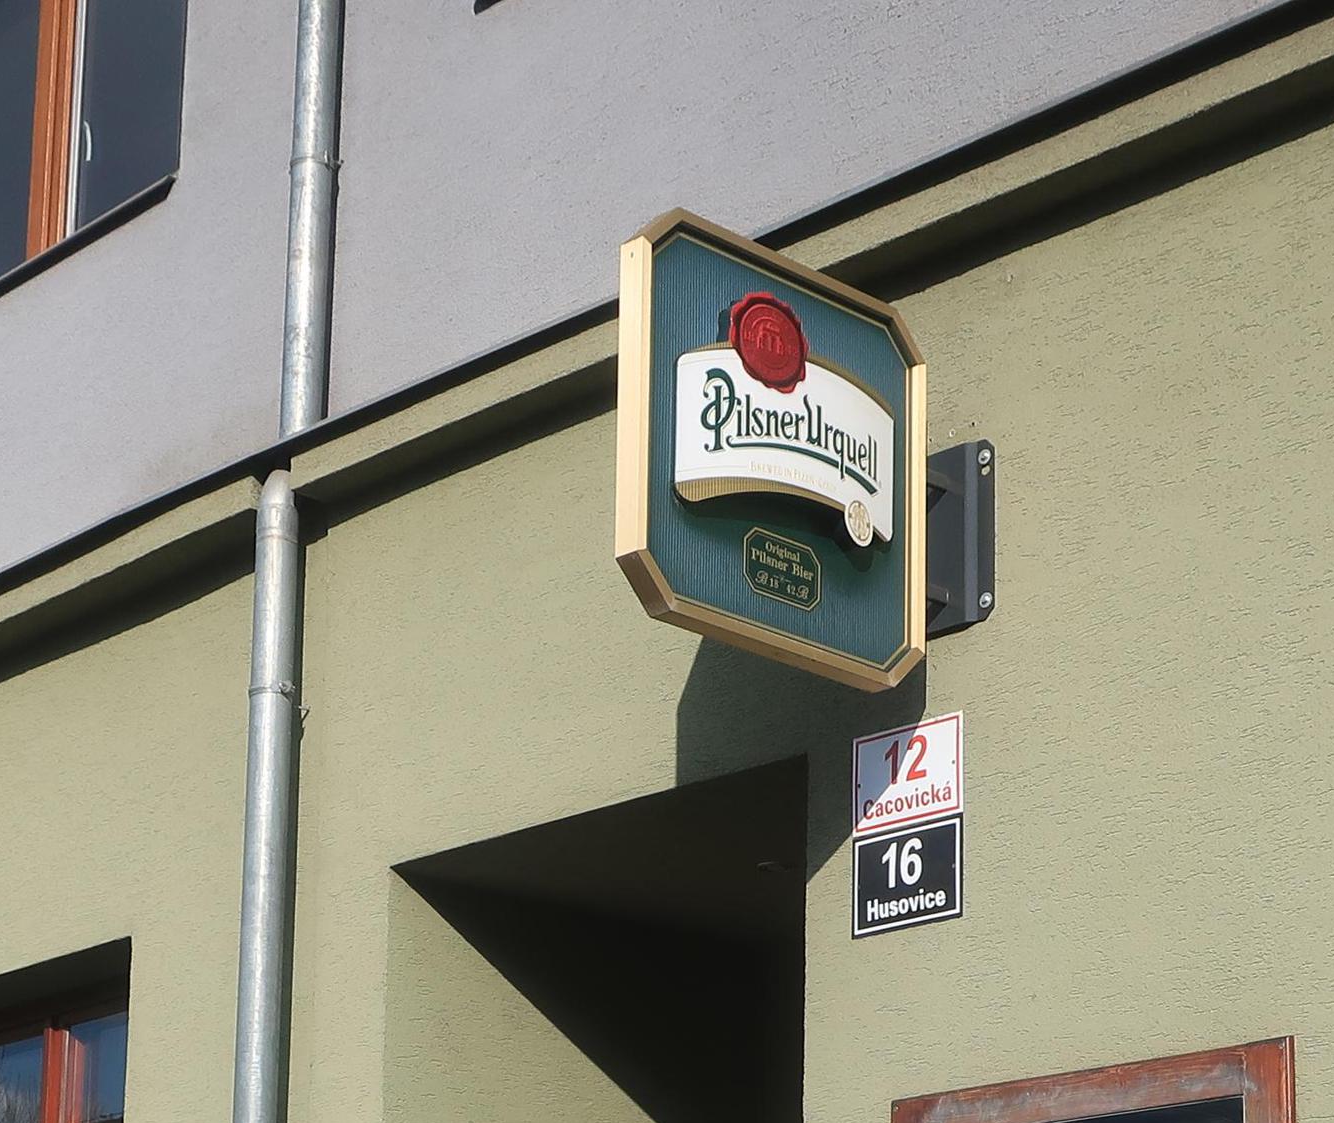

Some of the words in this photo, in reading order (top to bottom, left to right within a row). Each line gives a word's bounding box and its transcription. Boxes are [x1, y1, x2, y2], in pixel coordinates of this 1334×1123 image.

[700, 367, 806, 452] Pilsner
[802, 393, 878, 482] Urquell
[751, 547, 788, 572] Pilsner
[792, 562, 814, 581] Bier
[765, 541, 801, 563] Original
[884, 734, 928, 785] 12
[862, 781, 952, 820] Cacovická
[881, 837, 923, 889] 16
[866, 888, 947, 922] Husovice
